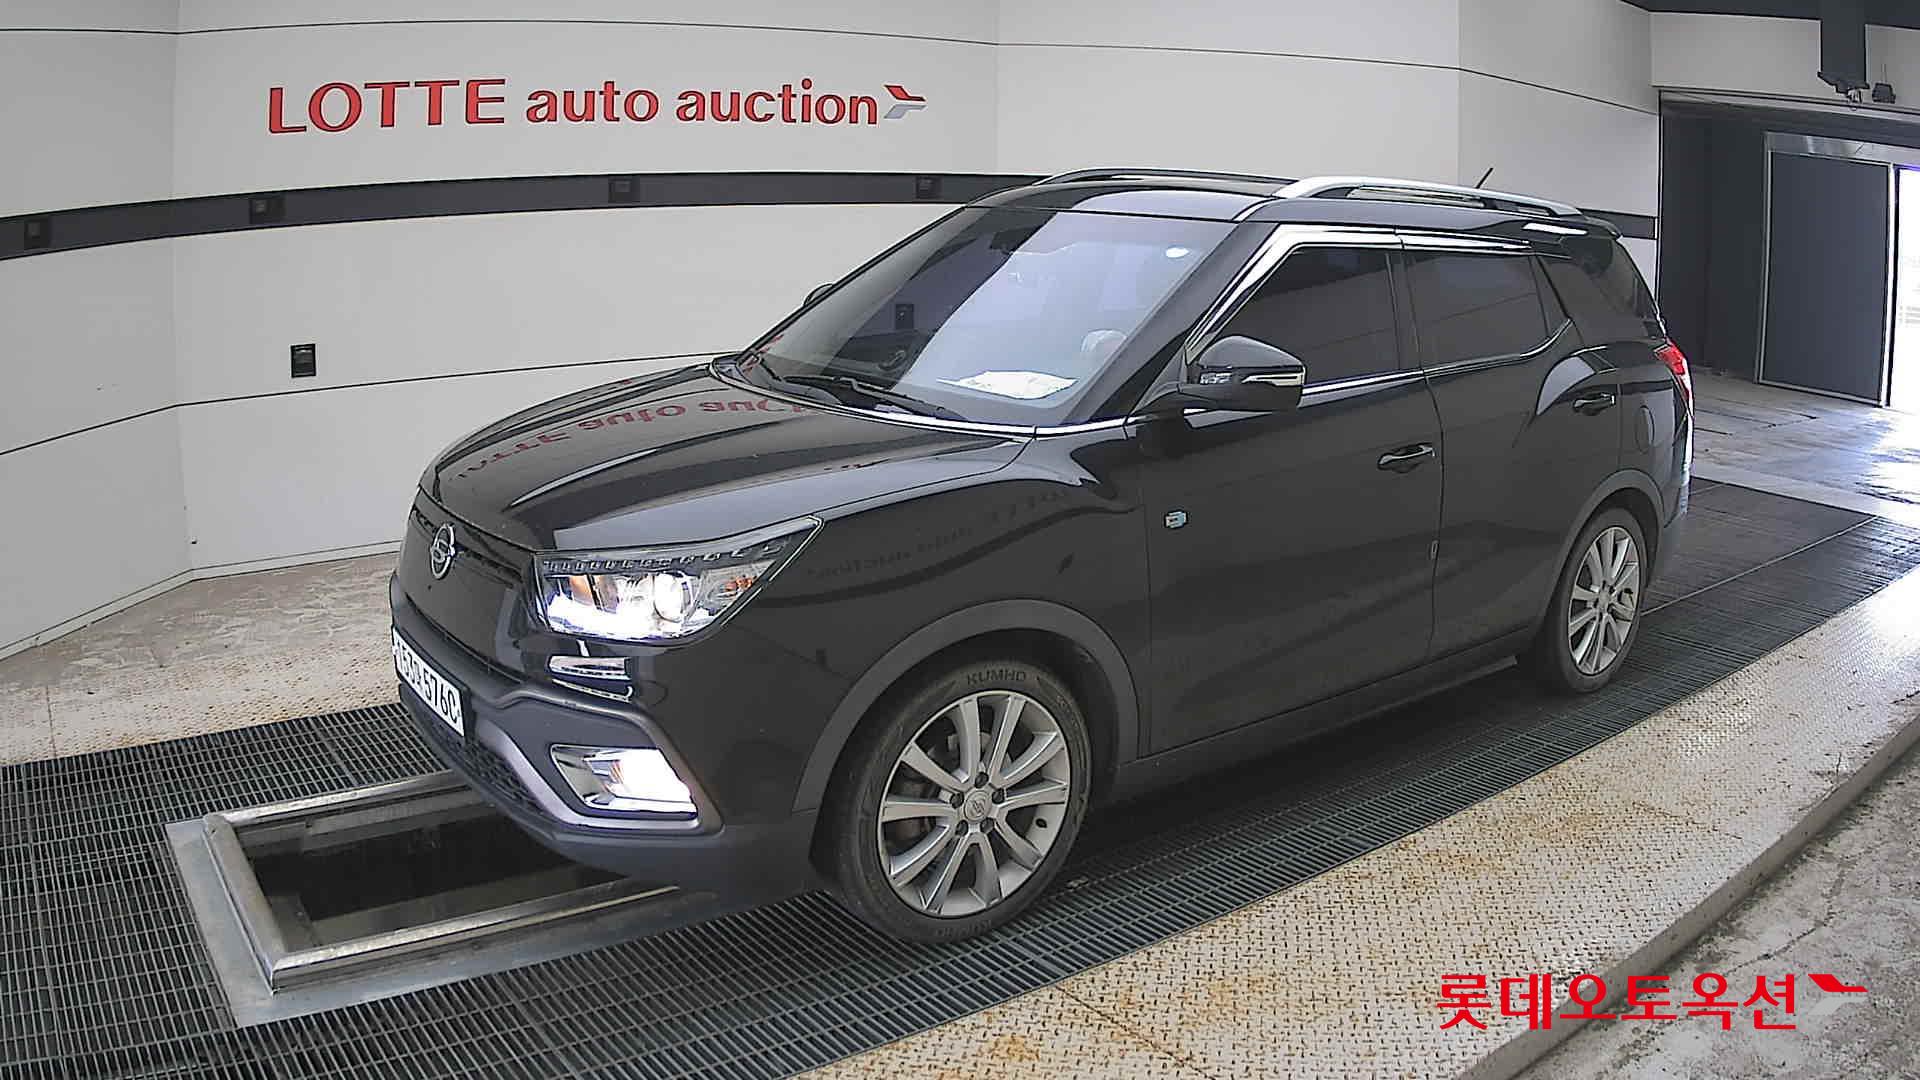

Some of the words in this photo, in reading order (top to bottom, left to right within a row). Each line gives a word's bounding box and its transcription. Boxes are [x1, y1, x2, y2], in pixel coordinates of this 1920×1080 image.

[269, 78, 505, 134] LOTTE
[526, 80, 659, 124] auto
[676, 78, 879, 125] auction
[967, 668, 1026, 687] KUMHO
